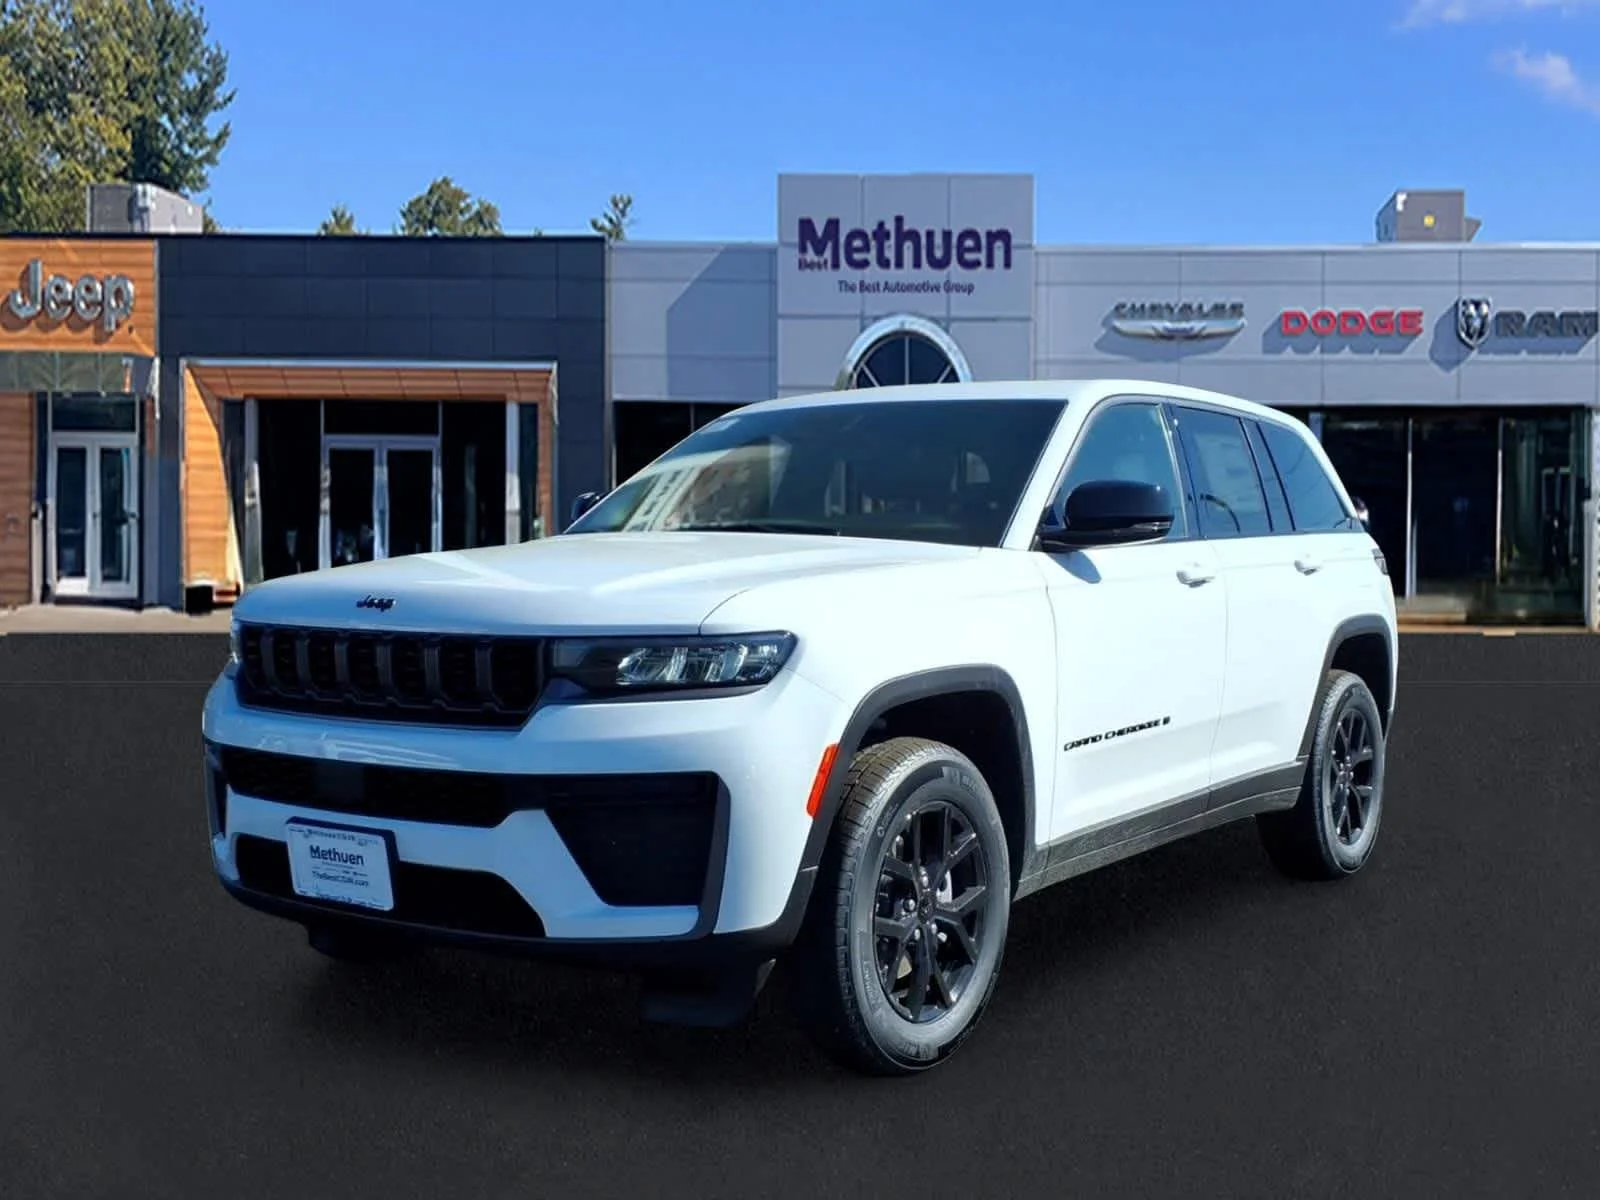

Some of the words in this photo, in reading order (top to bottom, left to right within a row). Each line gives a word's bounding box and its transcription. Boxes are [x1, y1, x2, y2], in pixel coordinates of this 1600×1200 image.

[798, 215, 1012, 271] Methuen
[9, 259, 135, 332] Jeep
[837, 279, 857, 294] The
[859, 279, 881, 294] Best
[882, 279, 941, 294] Automotive
[943, 279, 975, 297] Group
[1113, 301, 1245, 320] CHRYSLER
[1280, 310, 1423, 337] DODGE
[1495, 311, 1599, 337] RAM
[356, 594, 395, 613] Jeep
[1063, 733, 1103, 752] GRAND
[1104, 718, 1161, 740] CHEROKEE
[309, 844, 365, 866] Methuen
